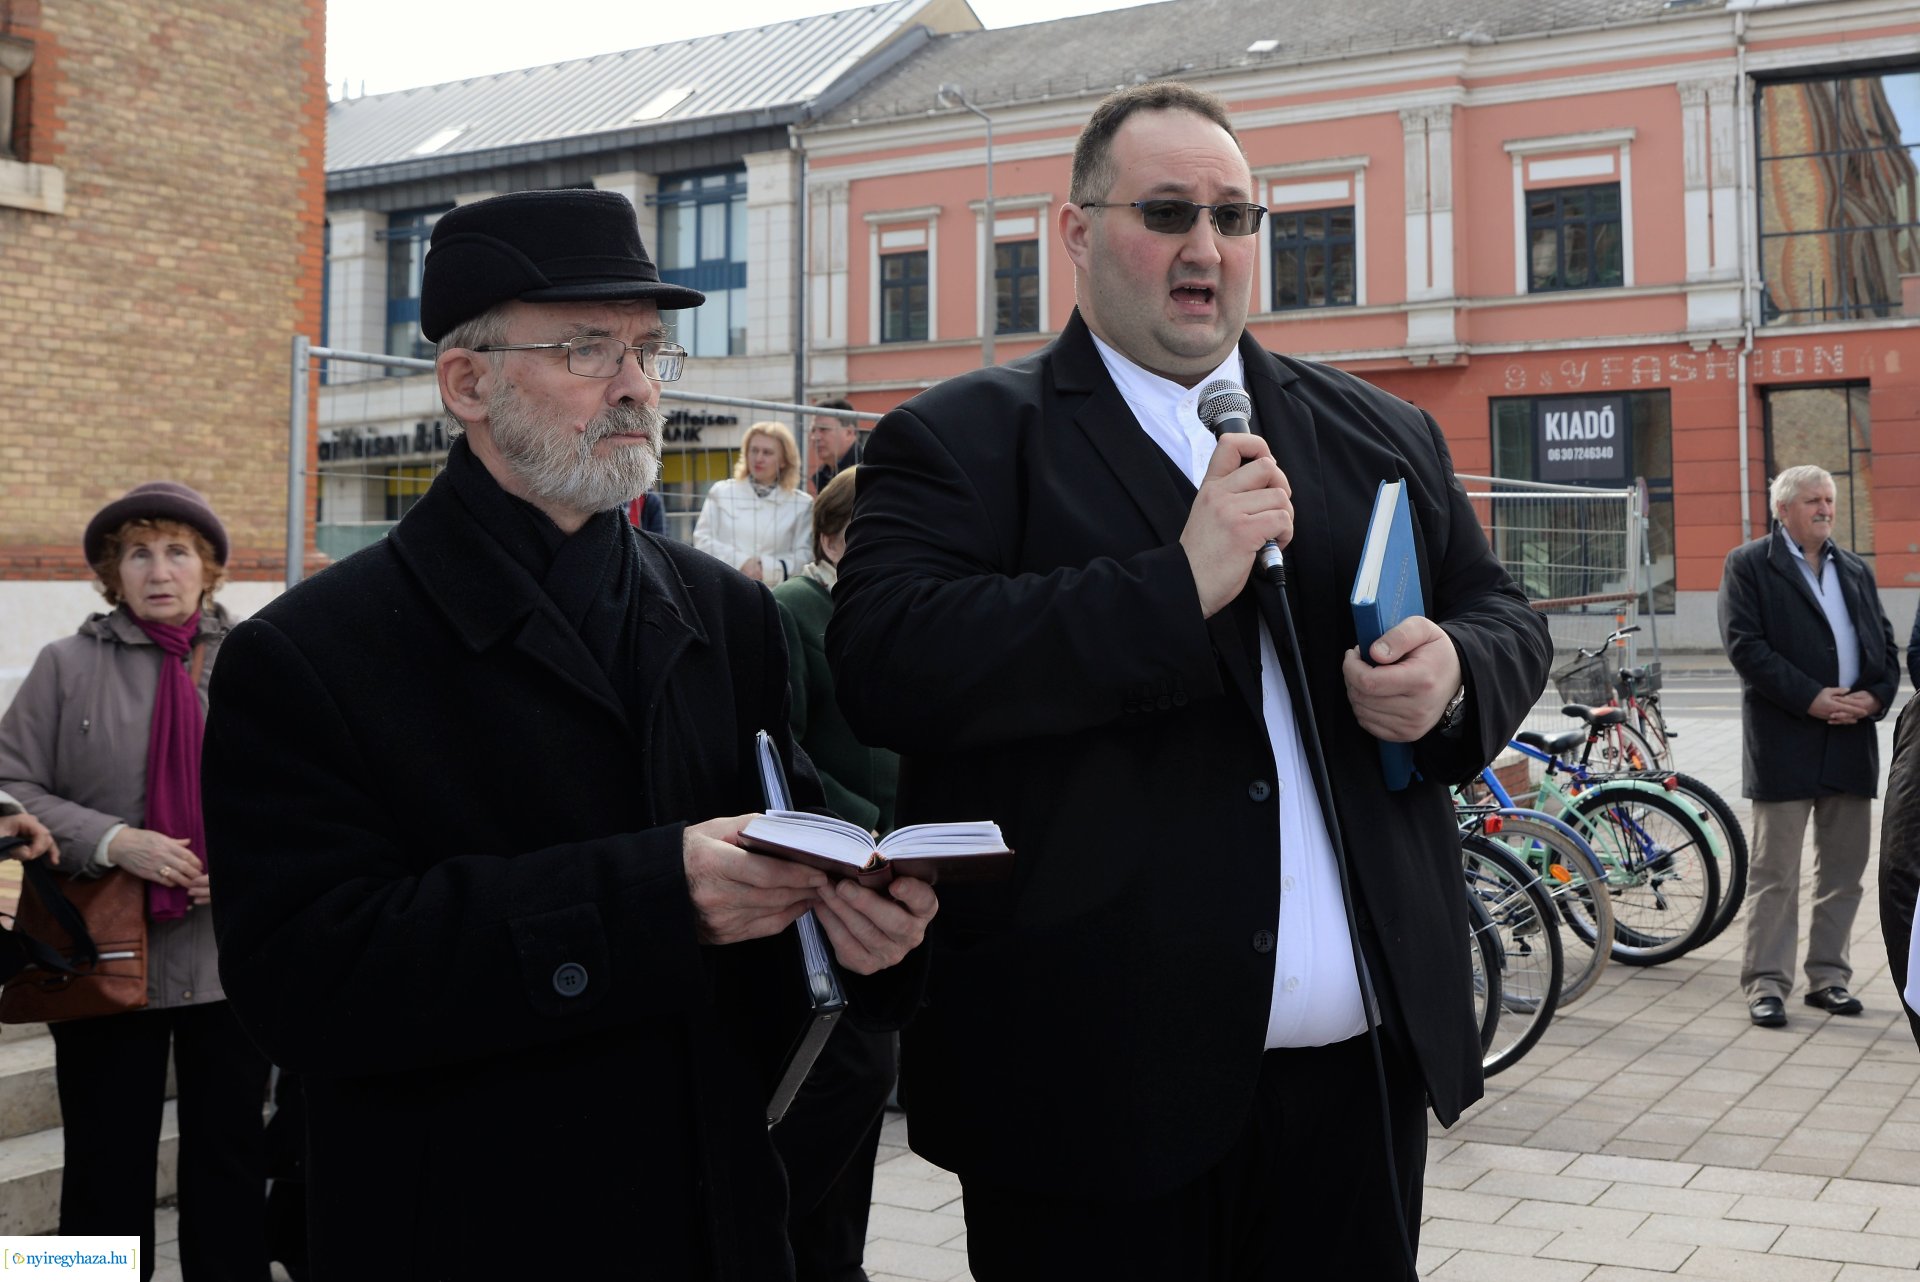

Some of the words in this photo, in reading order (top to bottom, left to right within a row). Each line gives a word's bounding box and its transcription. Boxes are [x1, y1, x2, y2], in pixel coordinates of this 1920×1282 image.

[1602, 344, 1844, 386] FASHION
[662, 425, 703, 442] ANK
[1545, 405, 1615, 441] KIADÓ
